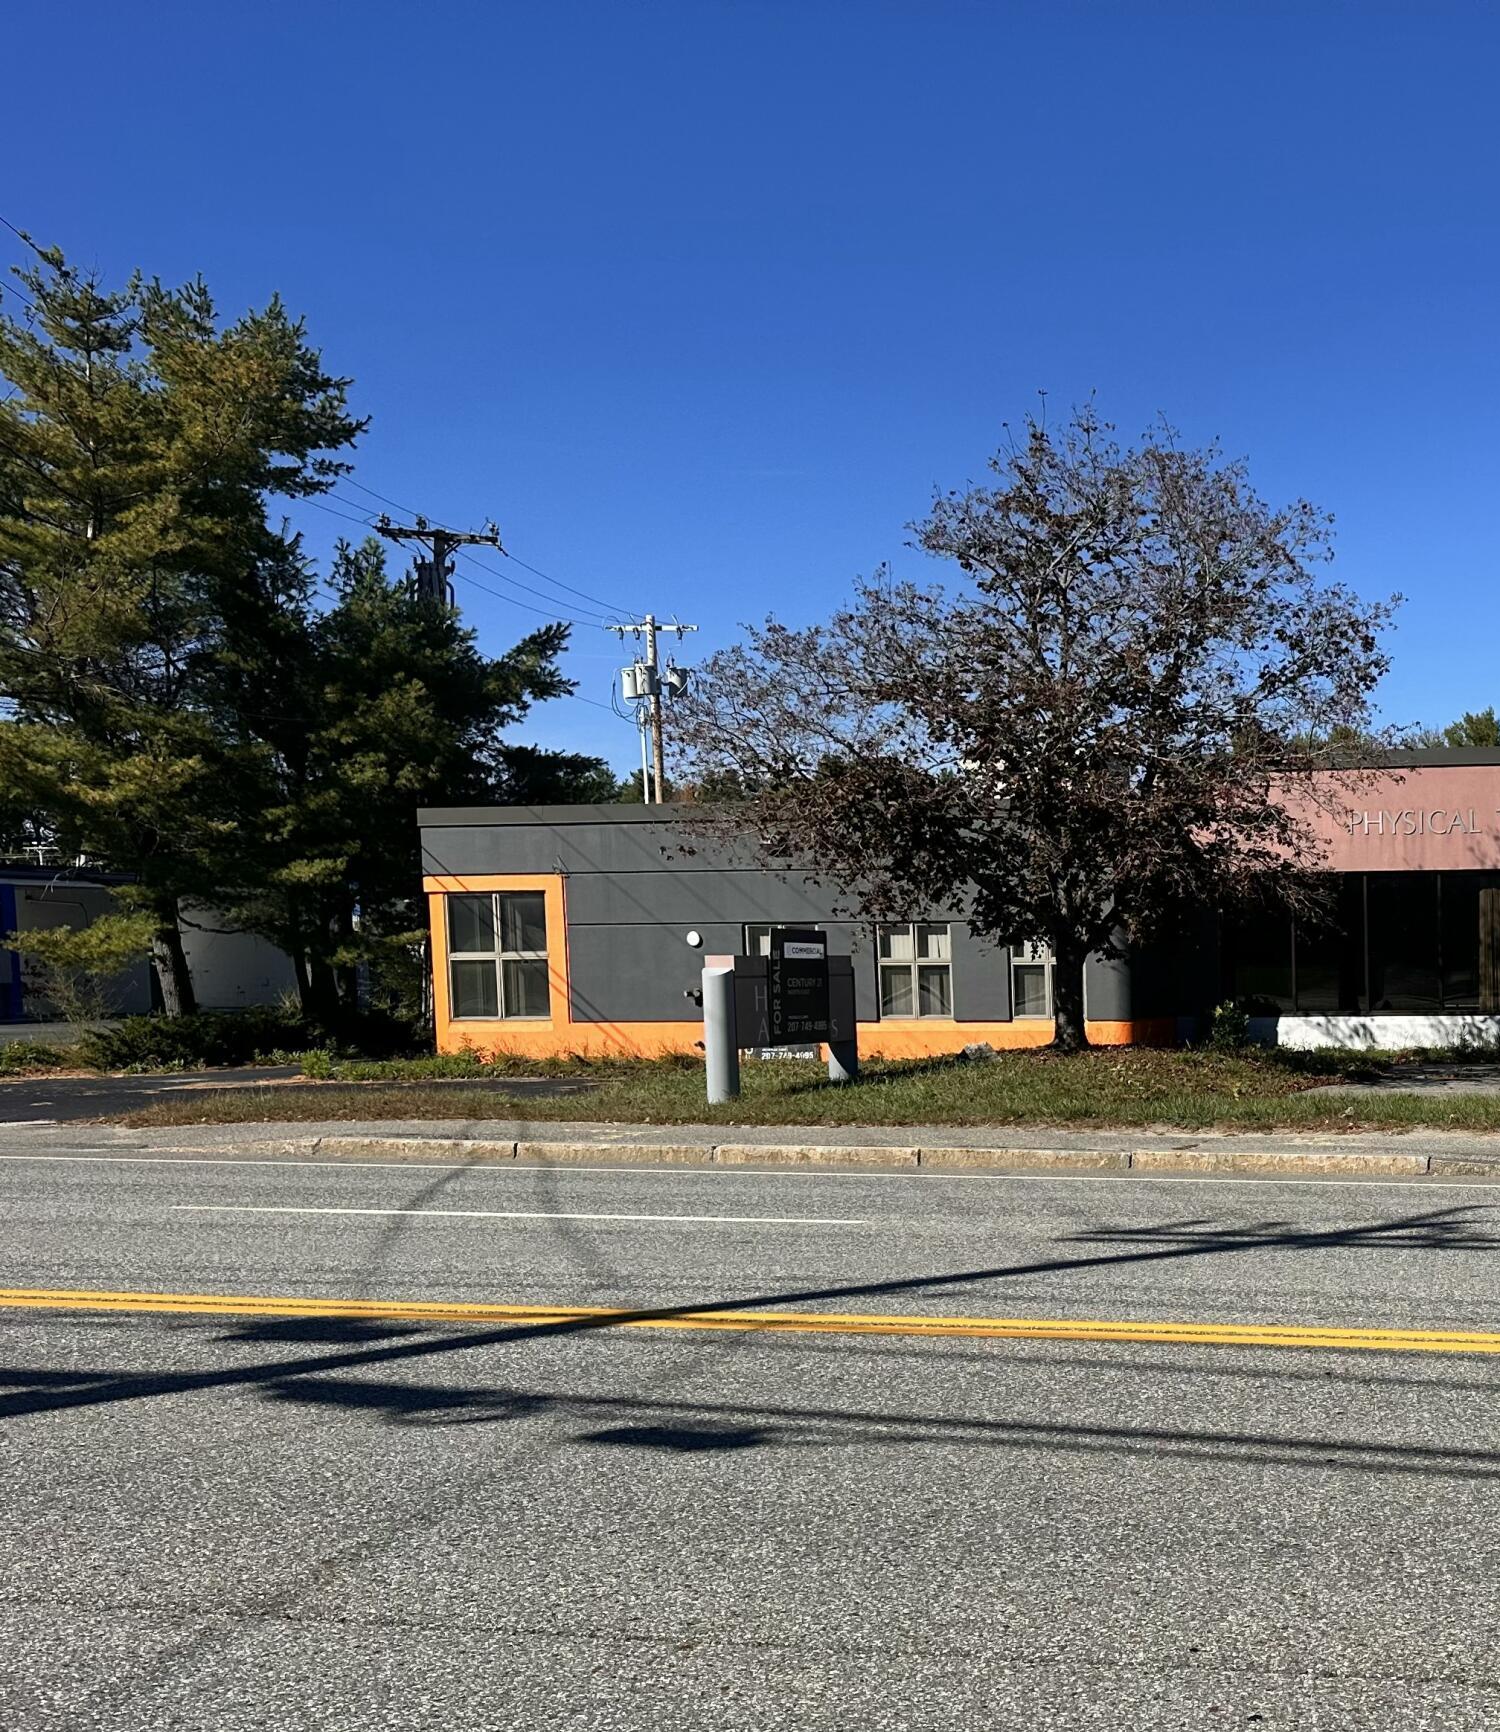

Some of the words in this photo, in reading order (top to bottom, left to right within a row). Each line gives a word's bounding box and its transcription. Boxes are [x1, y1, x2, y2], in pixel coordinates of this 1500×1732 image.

[1348, 808, 1482, 835] PHYSICAL
[772, 948, 781, 993] SALE
[787, 977, 816, 988] CENTURY
[772, 999, 782, 1035] FOR
